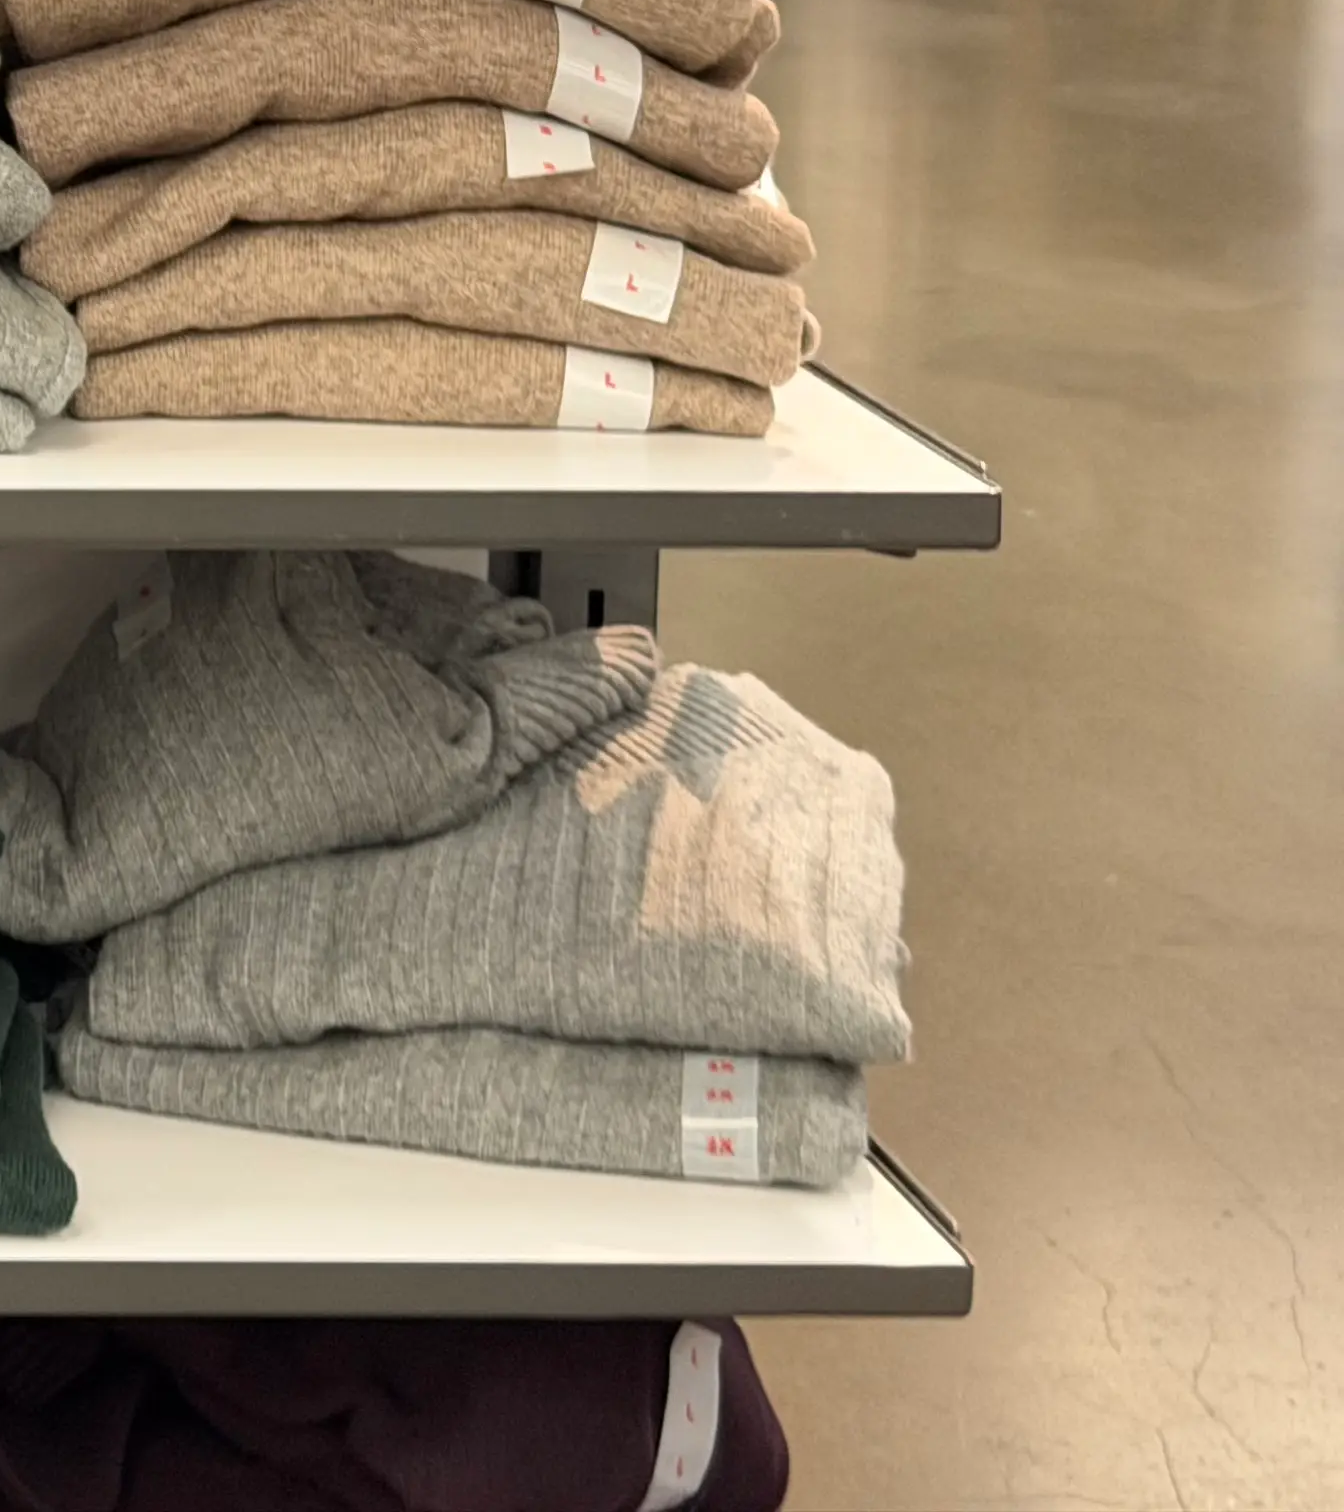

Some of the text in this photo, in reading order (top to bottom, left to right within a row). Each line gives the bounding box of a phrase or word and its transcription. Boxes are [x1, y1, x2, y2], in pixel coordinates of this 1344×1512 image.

[594, 63, 607, 84] L
[626, 273, 639, 294] L
[604, 370, 616, 390] L
